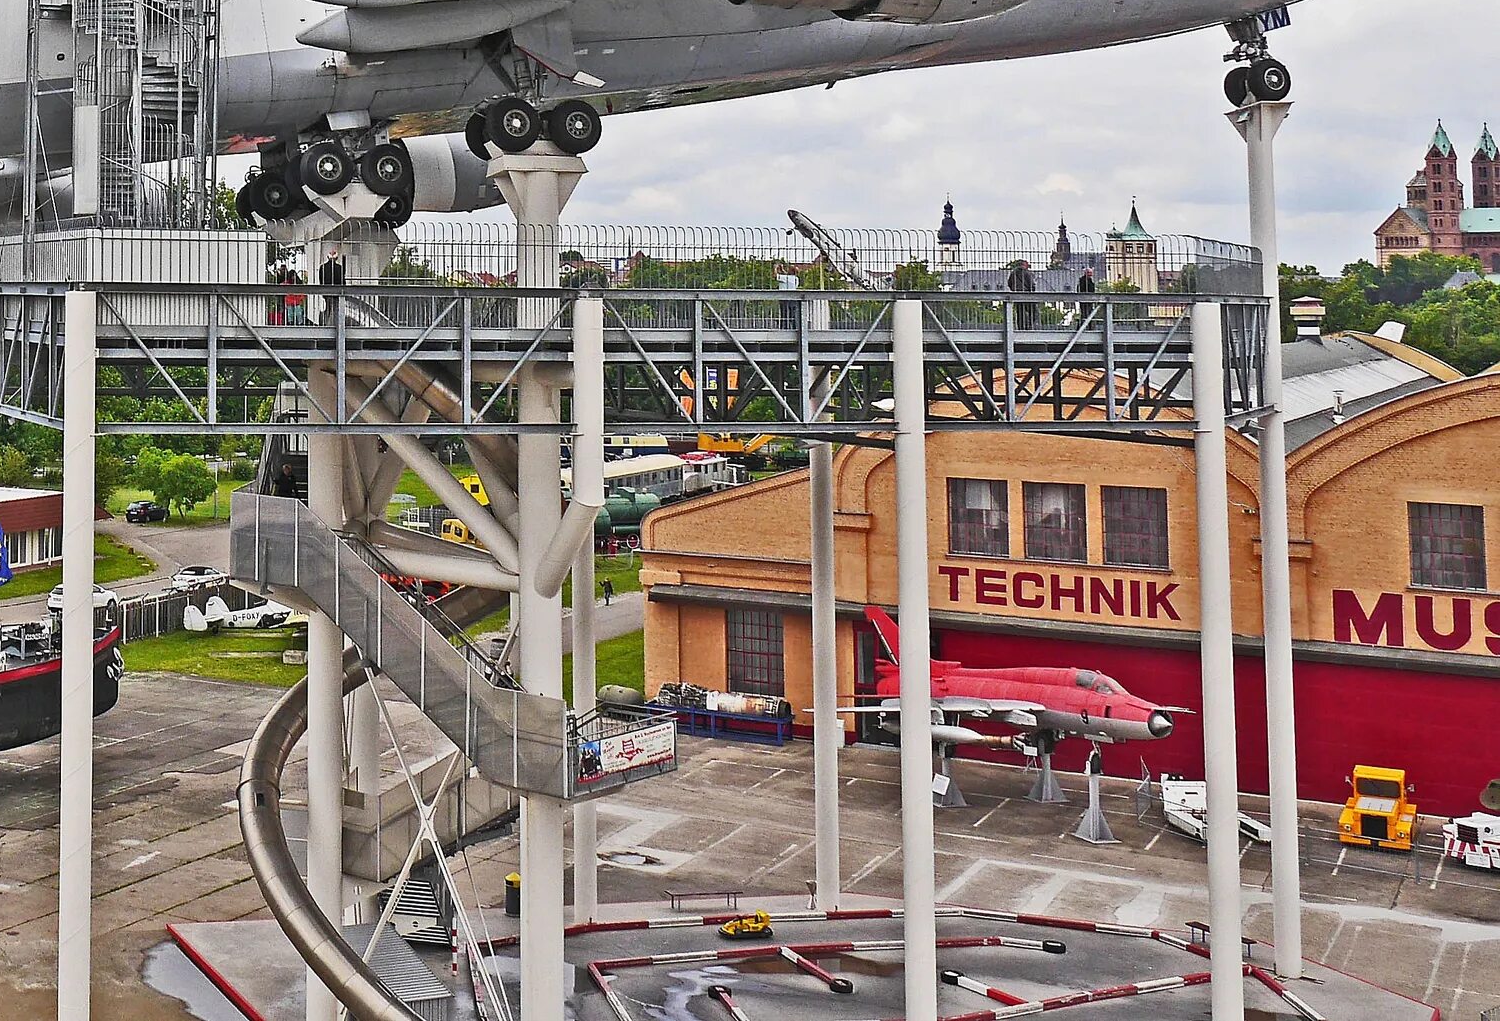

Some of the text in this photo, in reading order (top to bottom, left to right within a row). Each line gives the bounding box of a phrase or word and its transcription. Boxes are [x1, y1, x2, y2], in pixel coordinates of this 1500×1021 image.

[1257, 7, 1291, 32] YM
[938, 566, 1181, 621] TECHNIK
[232, 611, 260, 622] D-FOXY
[1080, 708, 1089, 725] 9
